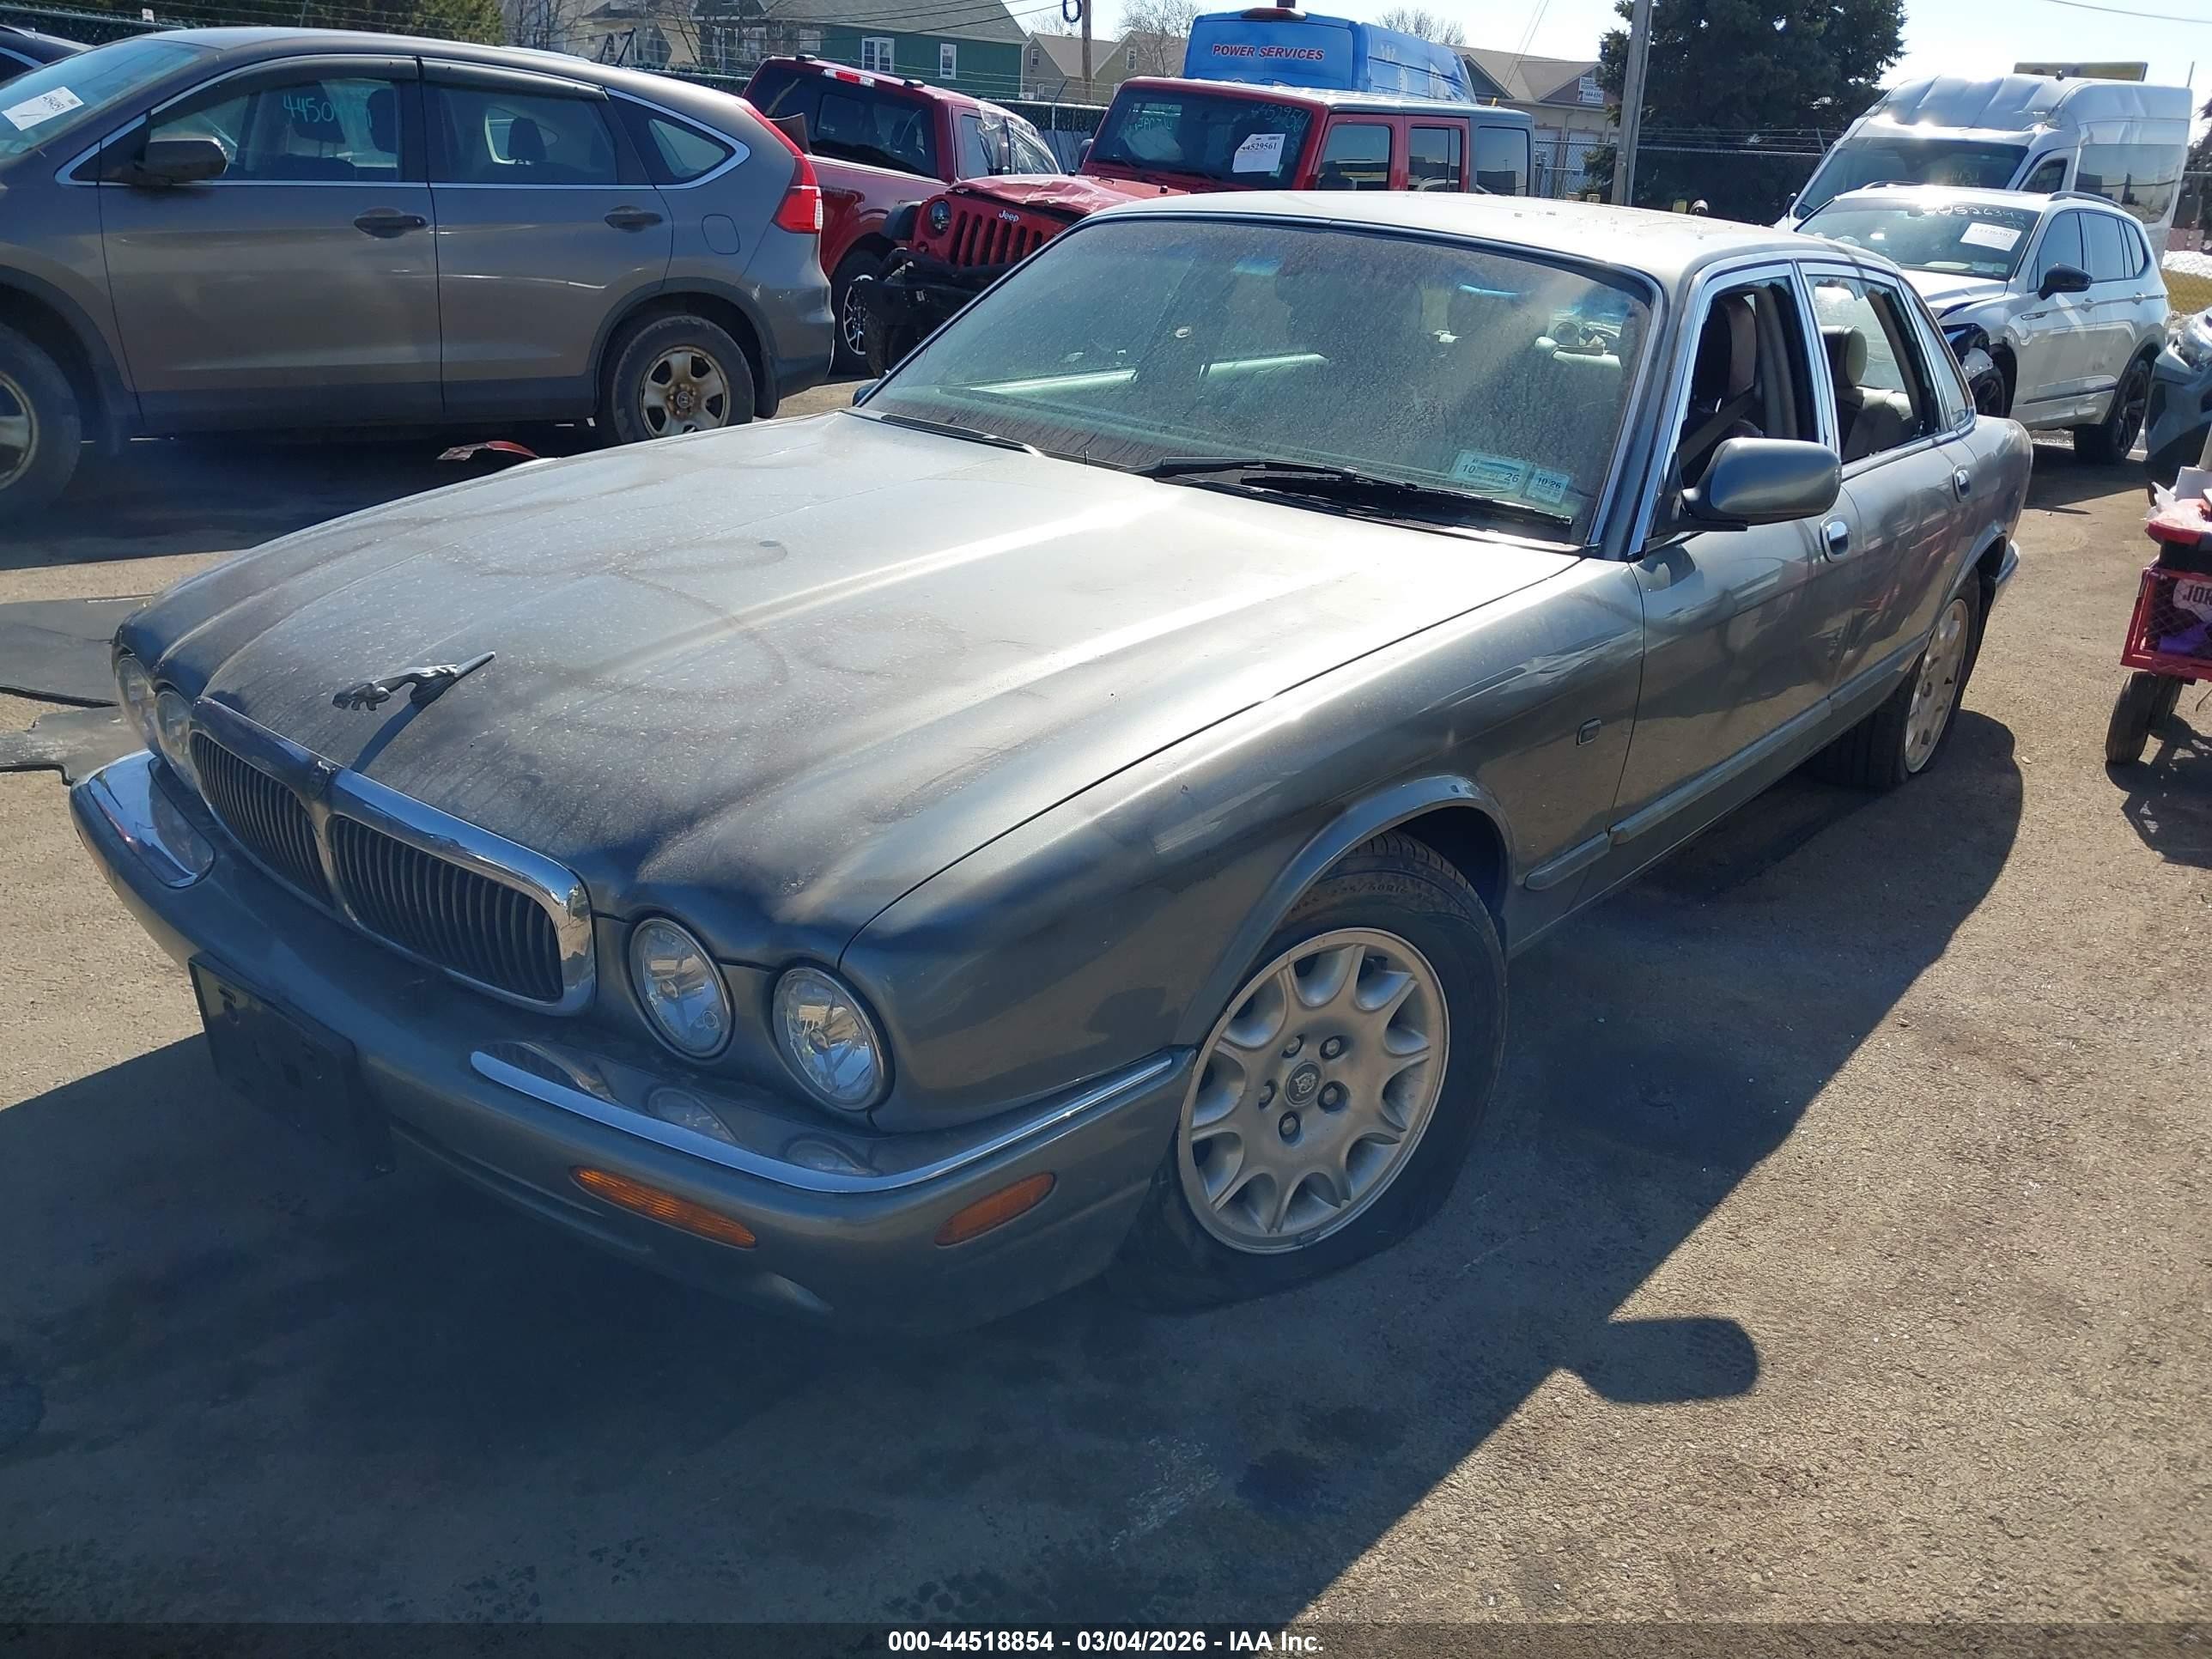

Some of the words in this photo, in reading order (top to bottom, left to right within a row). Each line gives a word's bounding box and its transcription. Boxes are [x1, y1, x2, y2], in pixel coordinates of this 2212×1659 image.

[1212, 45, 1255, 57] POWER
[1258, 46, 1324, 60] SERVICES
[998, 210, 1019, 222] Jeep
[1462, 464, 1476, 474] 10
[1504, 471, 1520, 483] 26
